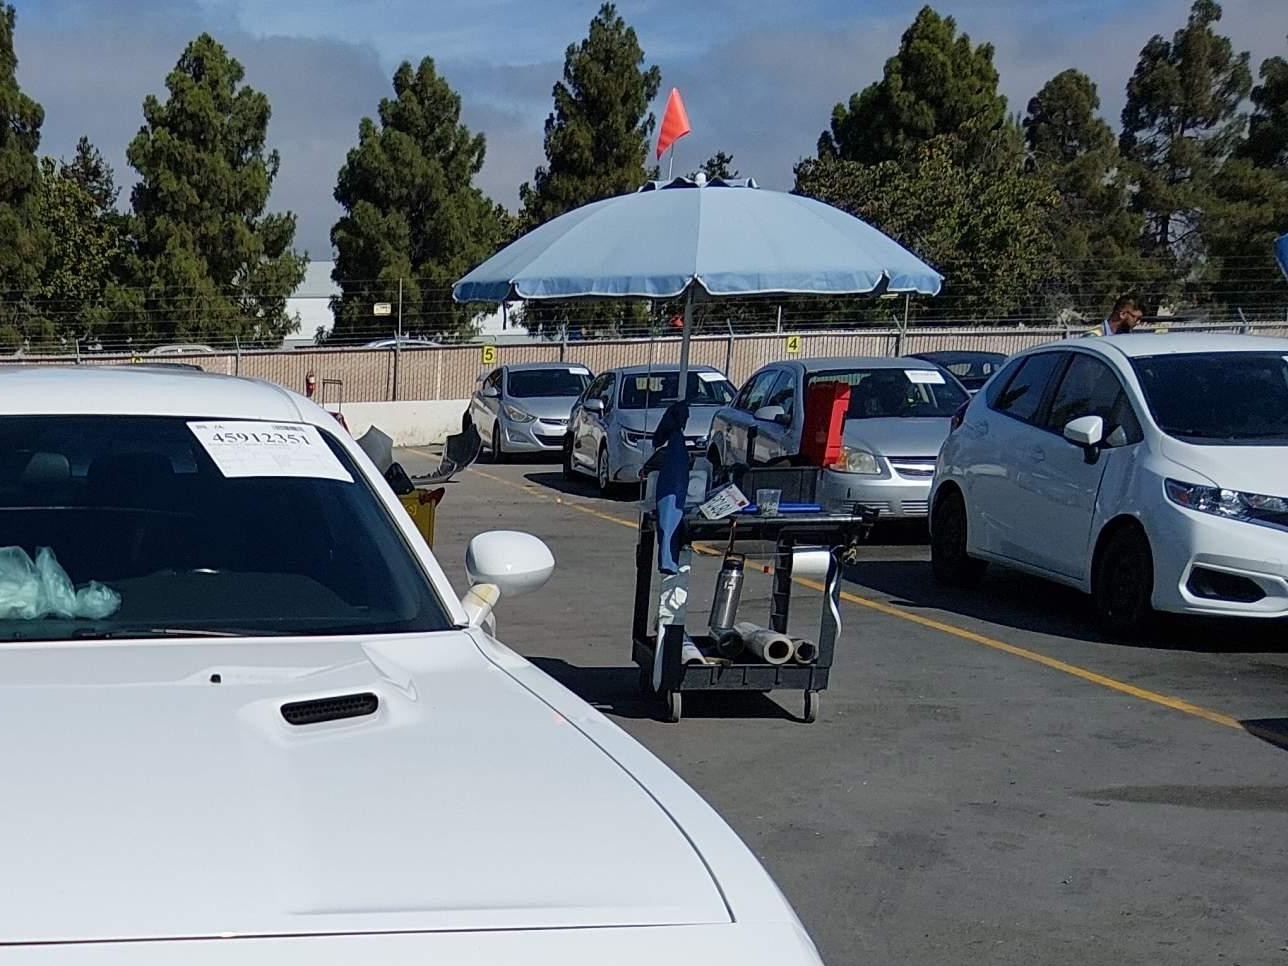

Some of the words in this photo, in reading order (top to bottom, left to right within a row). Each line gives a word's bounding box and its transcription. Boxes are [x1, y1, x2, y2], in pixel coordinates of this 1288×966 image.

[788, 337, 798, 350] 4
[484, 347, 494, 361] 5
[212, 432, 311, 445] 45912351
